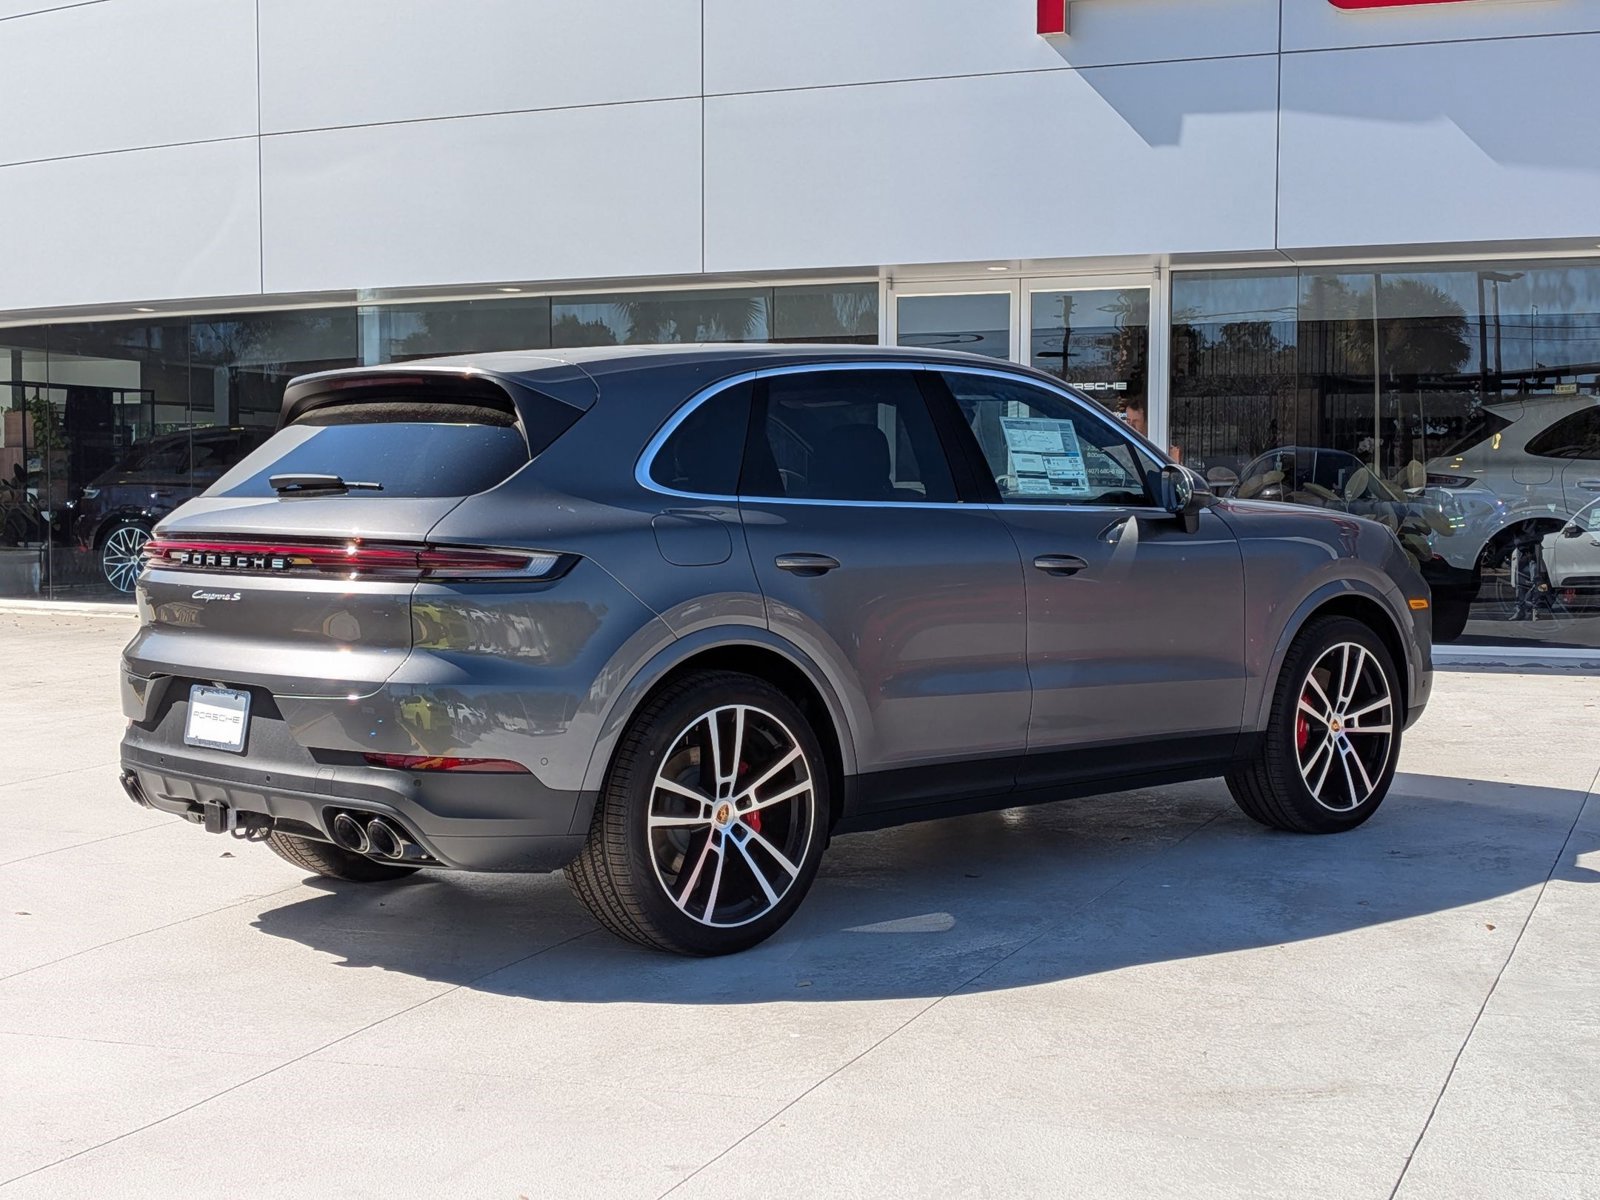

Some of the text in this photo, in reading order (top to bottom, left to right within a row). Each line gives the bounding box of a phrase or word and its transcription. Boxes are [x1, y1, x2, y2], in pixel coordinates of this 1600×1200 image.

[1067, 382, 1127, 390] RSCHE
[180, 553, 284, 569] PORSCHE
[191, 589, 241, 603] Cayenne S
[193, 711, 241, 724] PORSCHE
